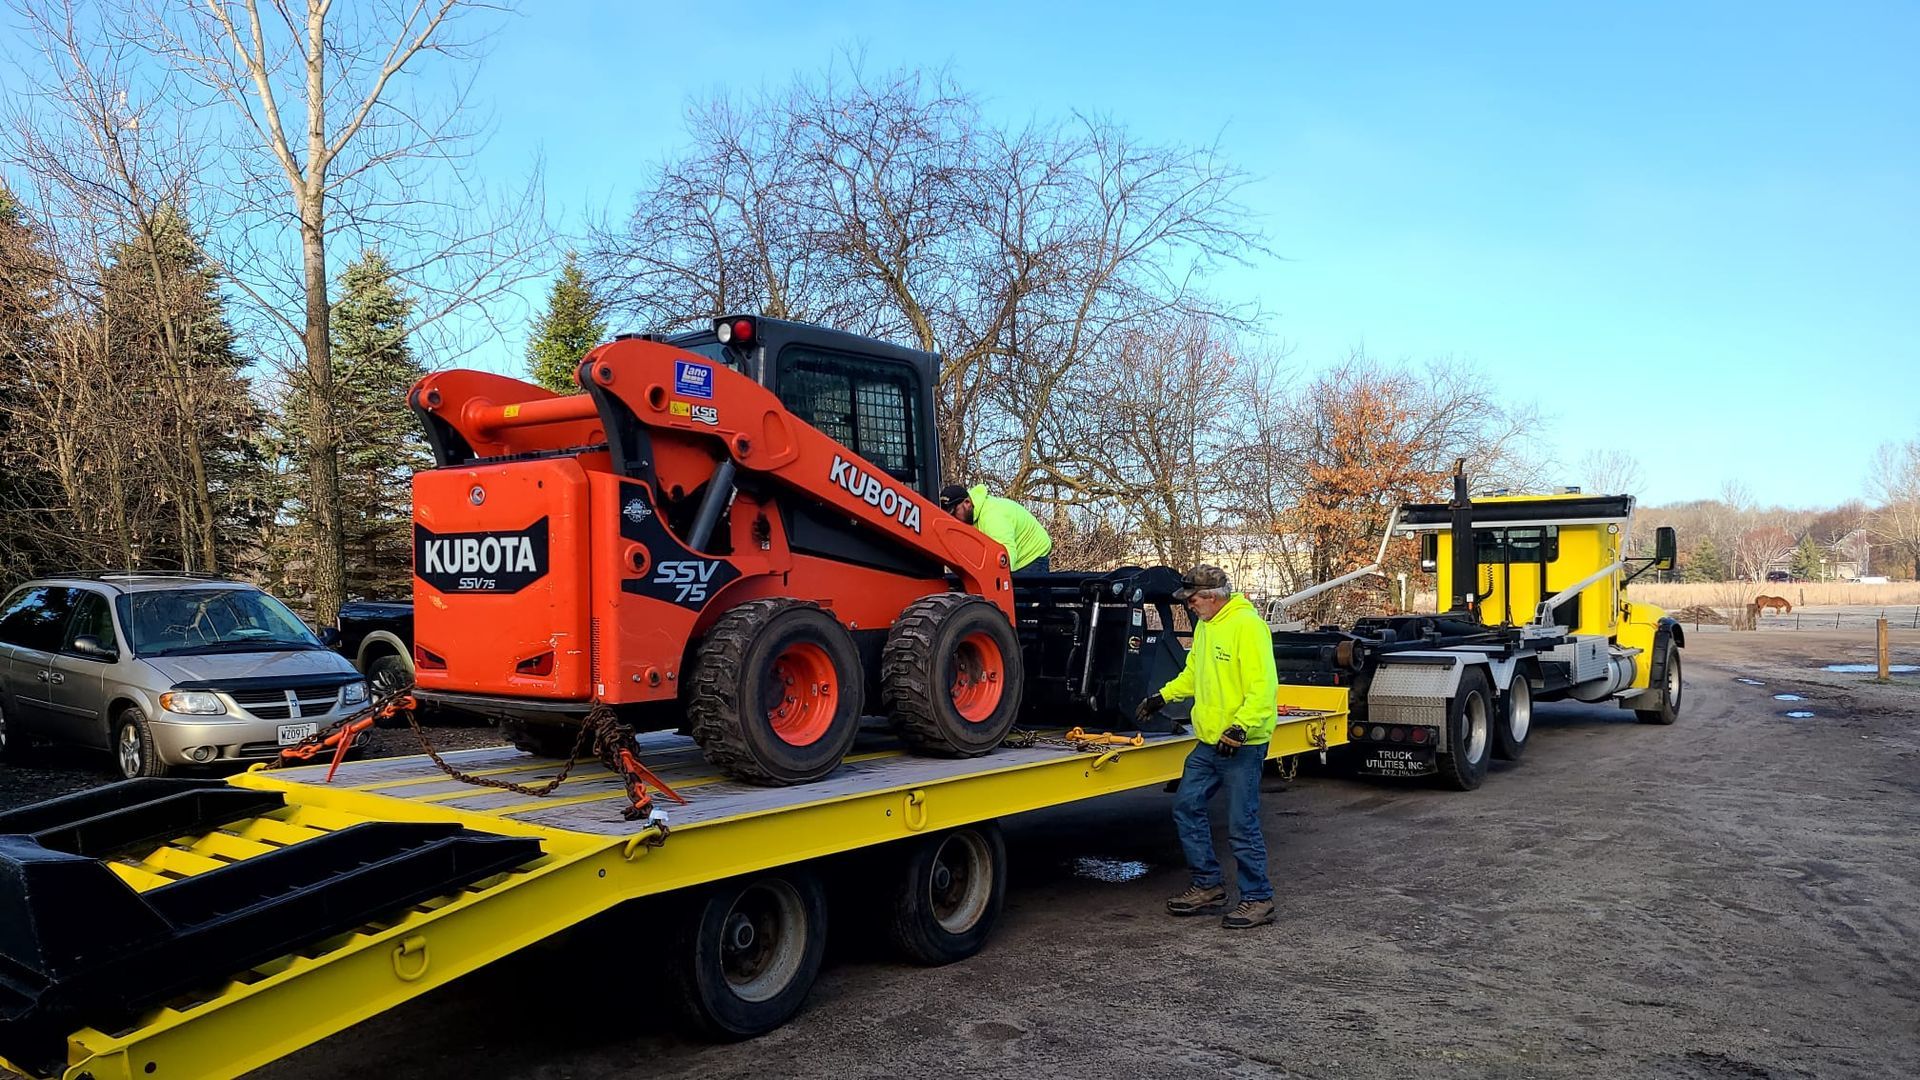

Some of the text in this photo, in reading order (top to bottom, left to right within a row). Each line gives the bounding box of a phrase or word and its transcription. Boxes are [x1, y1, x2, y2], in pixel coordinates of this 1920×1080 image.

[681, 364, 708, 382] Lano
[830, 455, 920, 533] KUBOTA
[425, 536, 537, 574] KUBOTA
[653, 561, 720, 583] SSV
[674, 584, 708, 602] 75
[1377, 750, 1413, 760] TRUCK
[1366, 759, 1407, 770] UTILITIES,
